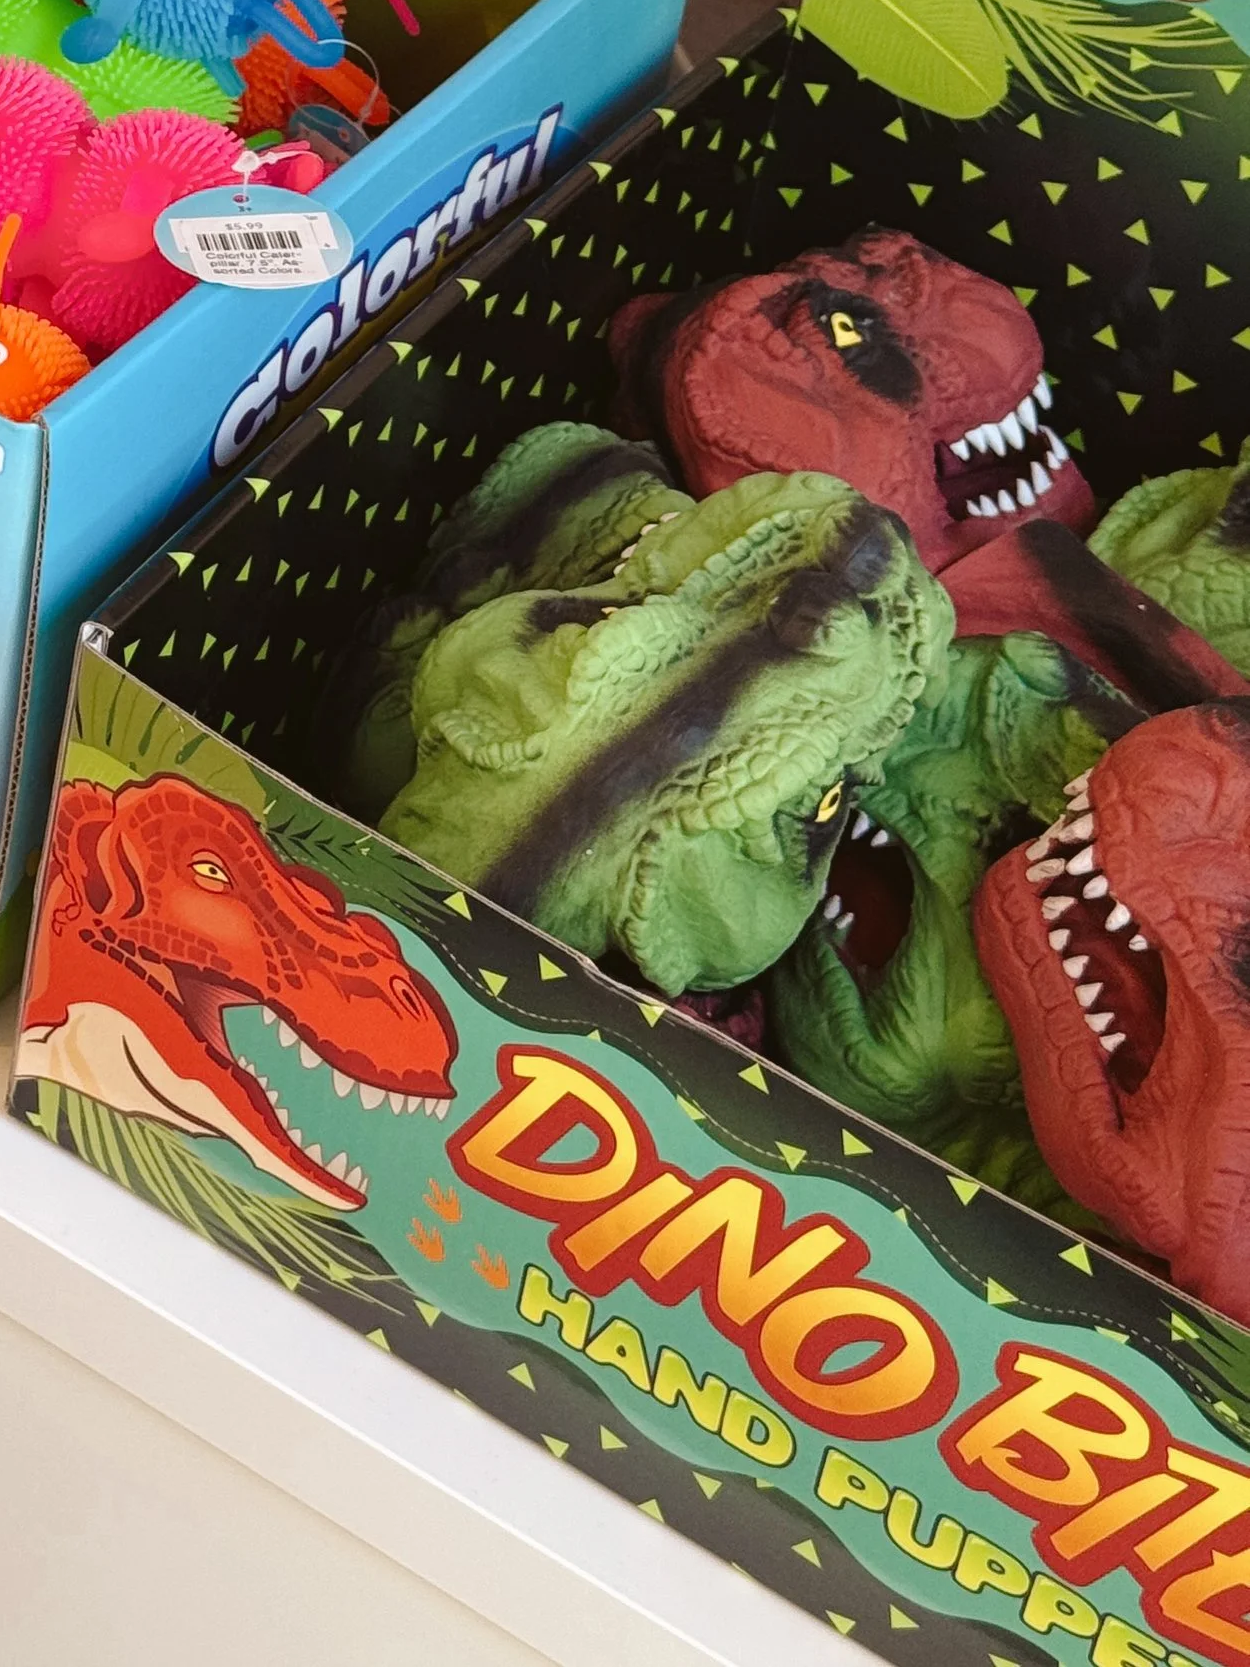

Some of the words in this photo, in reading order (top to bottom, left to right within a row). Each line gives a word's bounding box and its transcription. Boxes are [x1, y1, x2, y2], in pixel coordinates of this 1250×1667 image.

[205, 251, 257, 260] Colorful
[209, 102, 563, 475] Colorful
[213, 267, 255, 275] sorted
[225, 221, 264, 231] $5.99
[446, 1044, 958, 1441] DINO
[516, 1264, 796, 1470] HAND
[816, 1446, 1200, 1667] PUPPE
